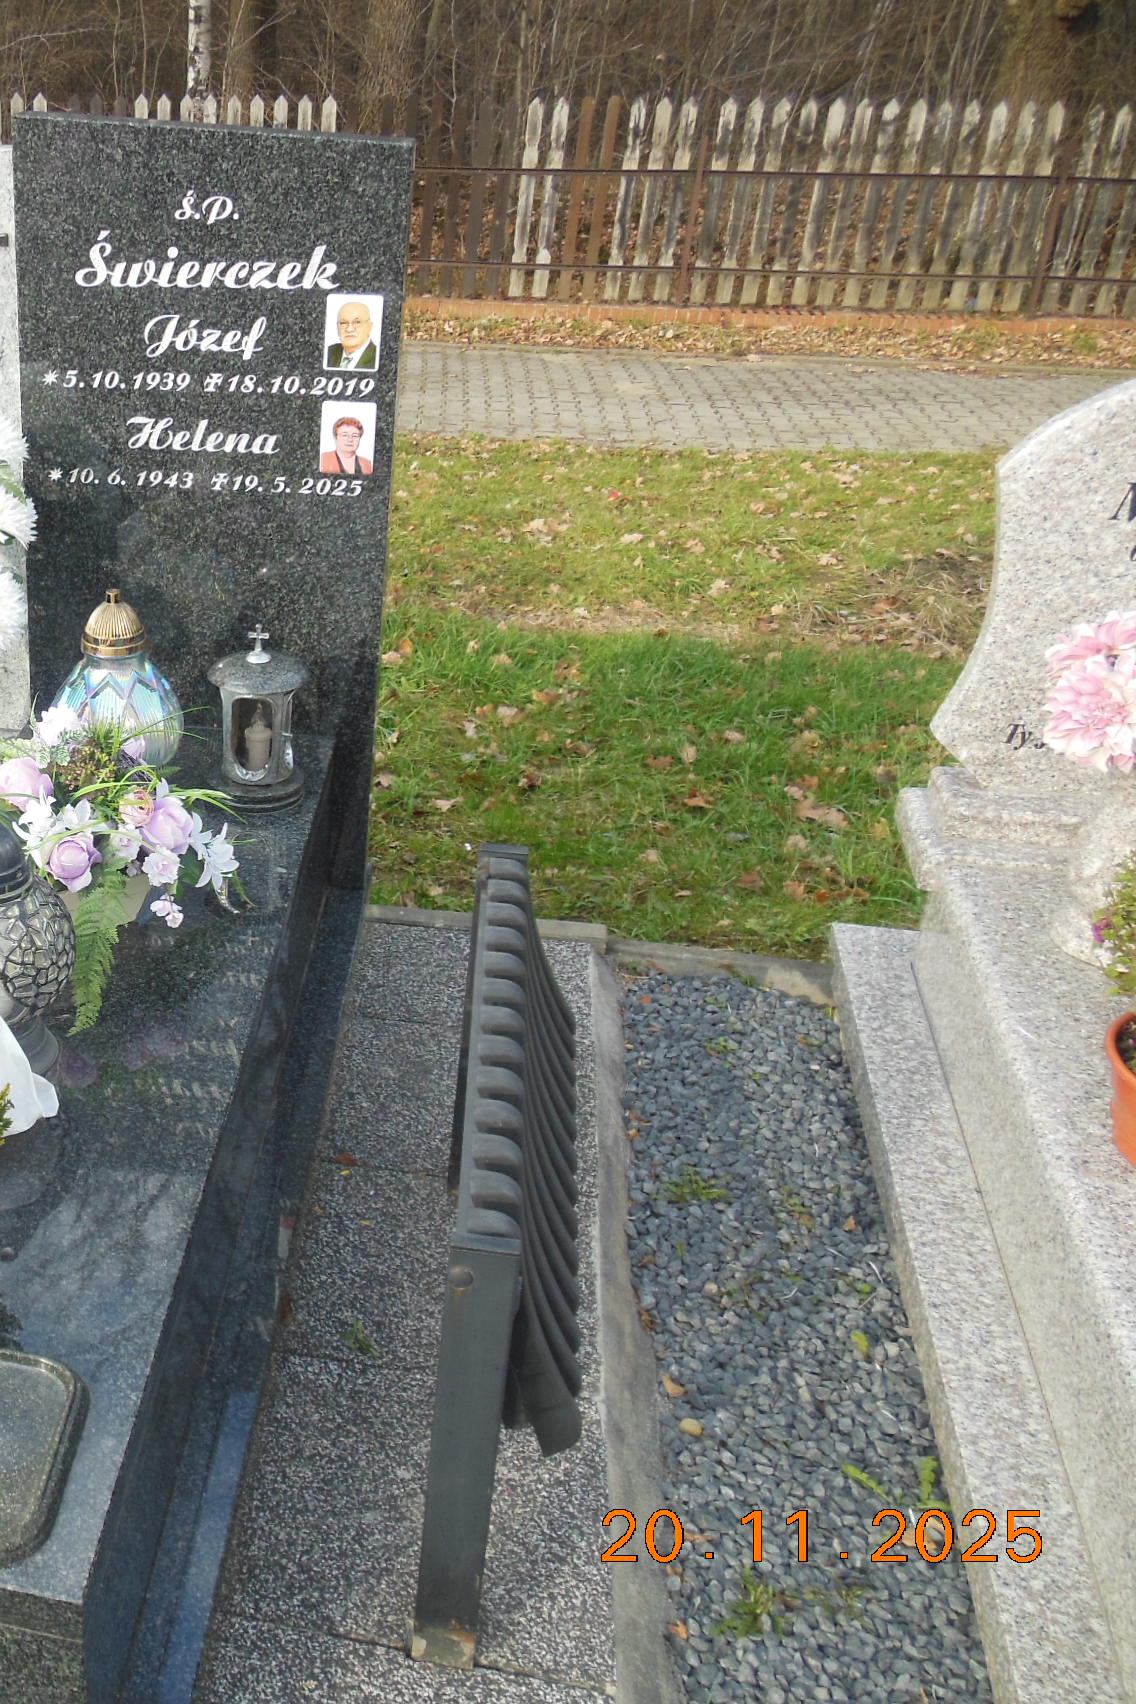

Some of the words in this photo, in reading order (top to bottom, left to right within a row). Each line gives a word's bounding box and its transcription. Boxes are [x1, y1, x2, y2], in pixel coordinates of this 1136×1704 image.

[74, 229, 340, 291] Świerczek
[142, 313, 268, 361] Józef
[125, 415, 281, 455] Helena
